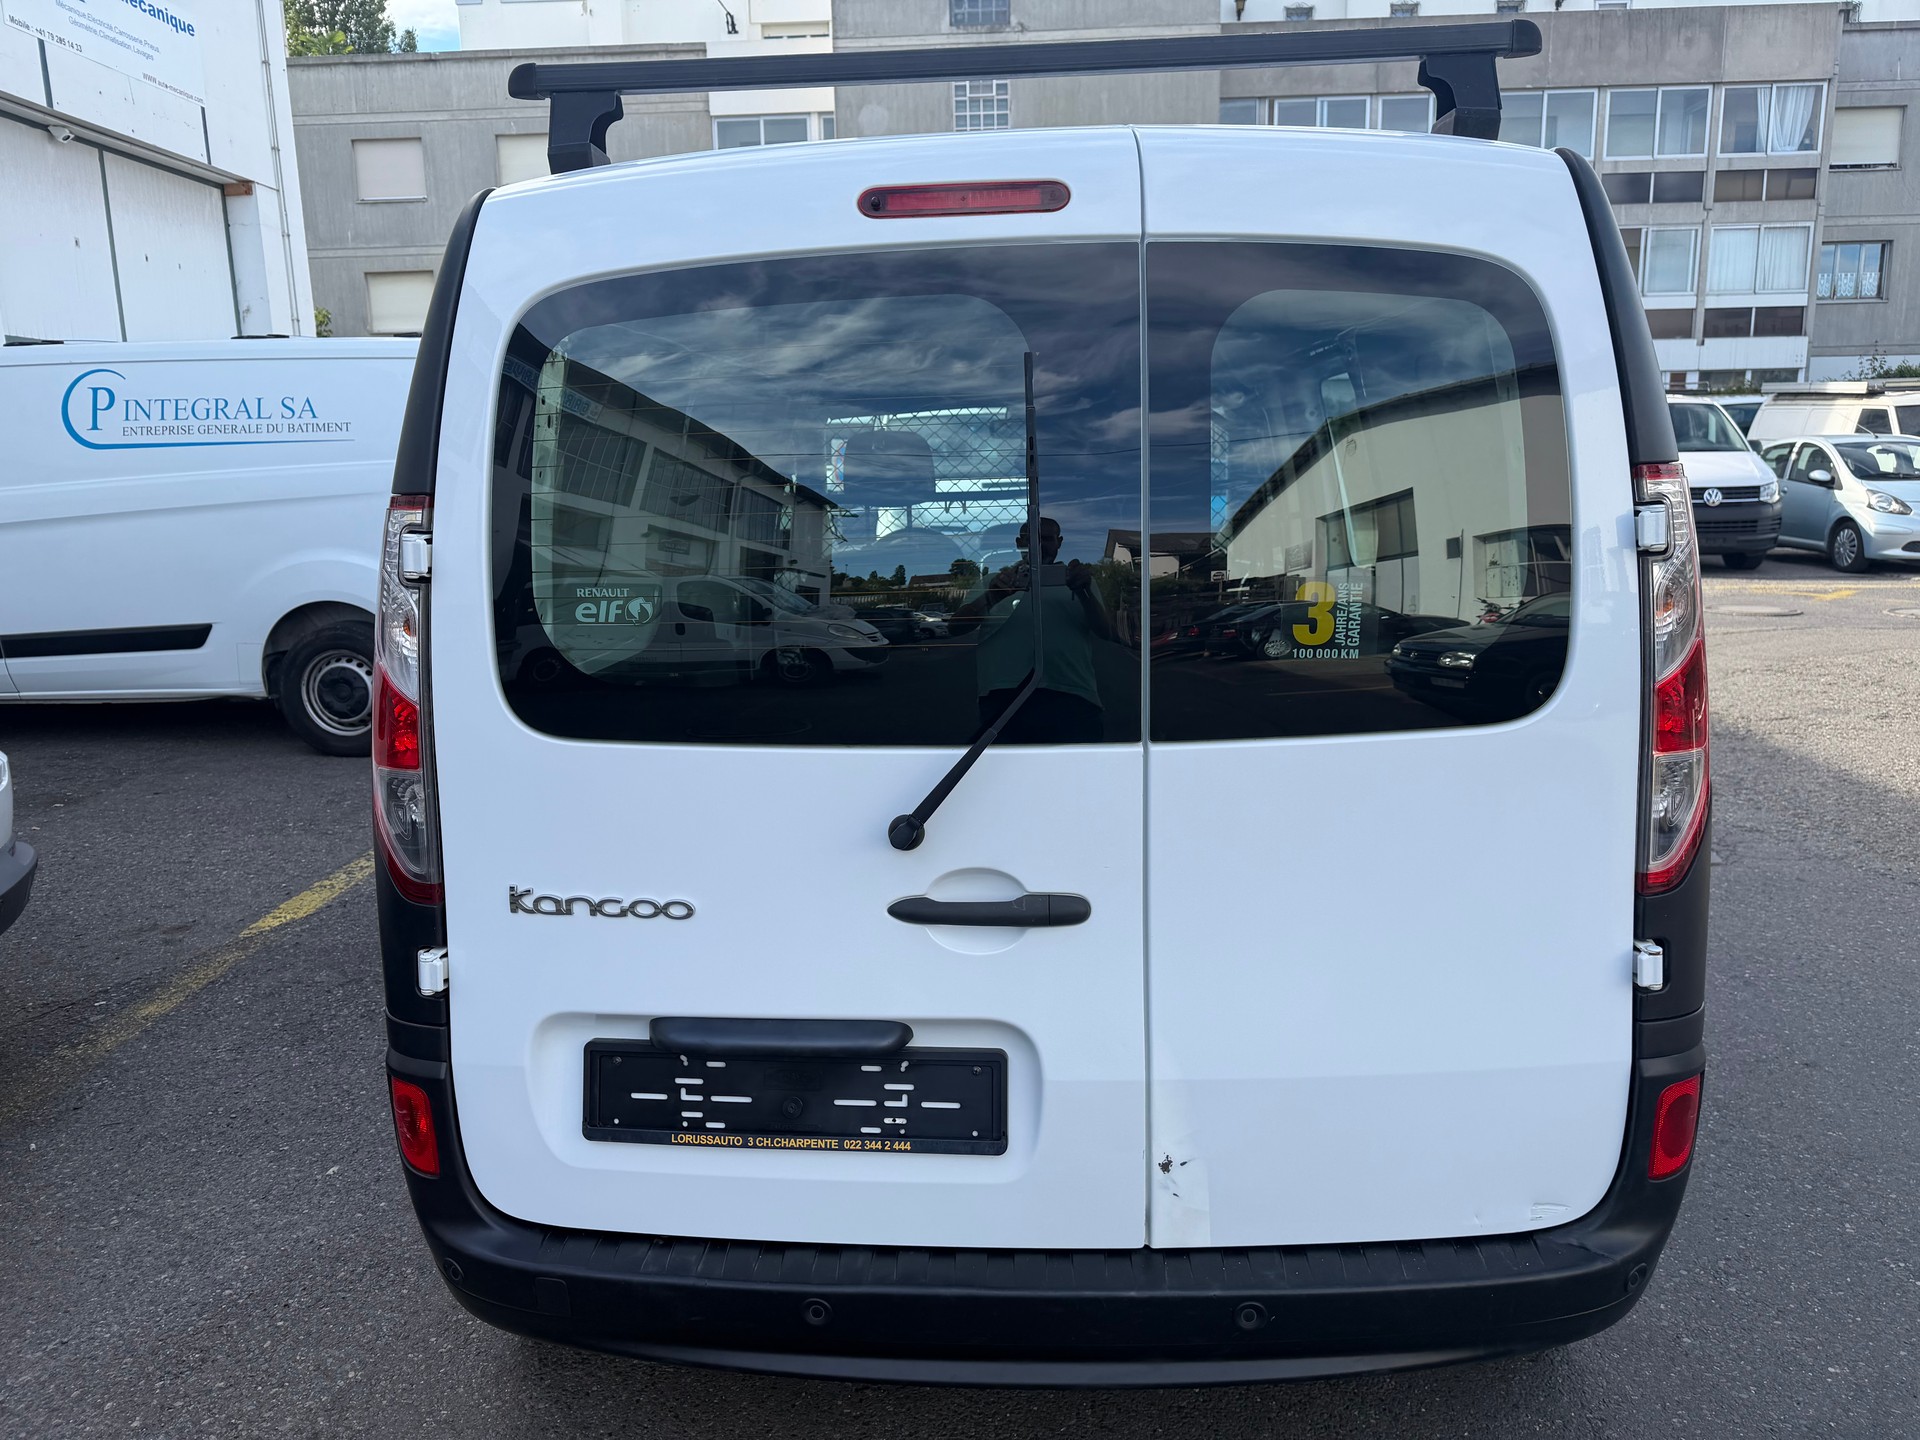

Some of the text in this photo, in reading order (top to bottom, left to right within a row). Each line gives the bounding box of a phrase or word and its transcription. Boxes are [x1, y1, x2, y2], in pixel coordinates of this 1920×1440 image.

[122, 397, 273, 421] INTEGRAL
[280, 396, 319, 420] SA
[122, 421, 352, 437] ENTREPRISE GENERALE DU BATIMENT
[576, 588, 630, 598] RENAULT
[575, 600, 624, 623] elf
[1292, 581, 1364, 647] 3 JAHRE/ANS GARANTIE
[1292, 648, 1360, 659] 100 000 KM
[671, 1133, 912, 1151] LORUSSAUTO 3 CH.CHARPENTE 022 344 2 444
